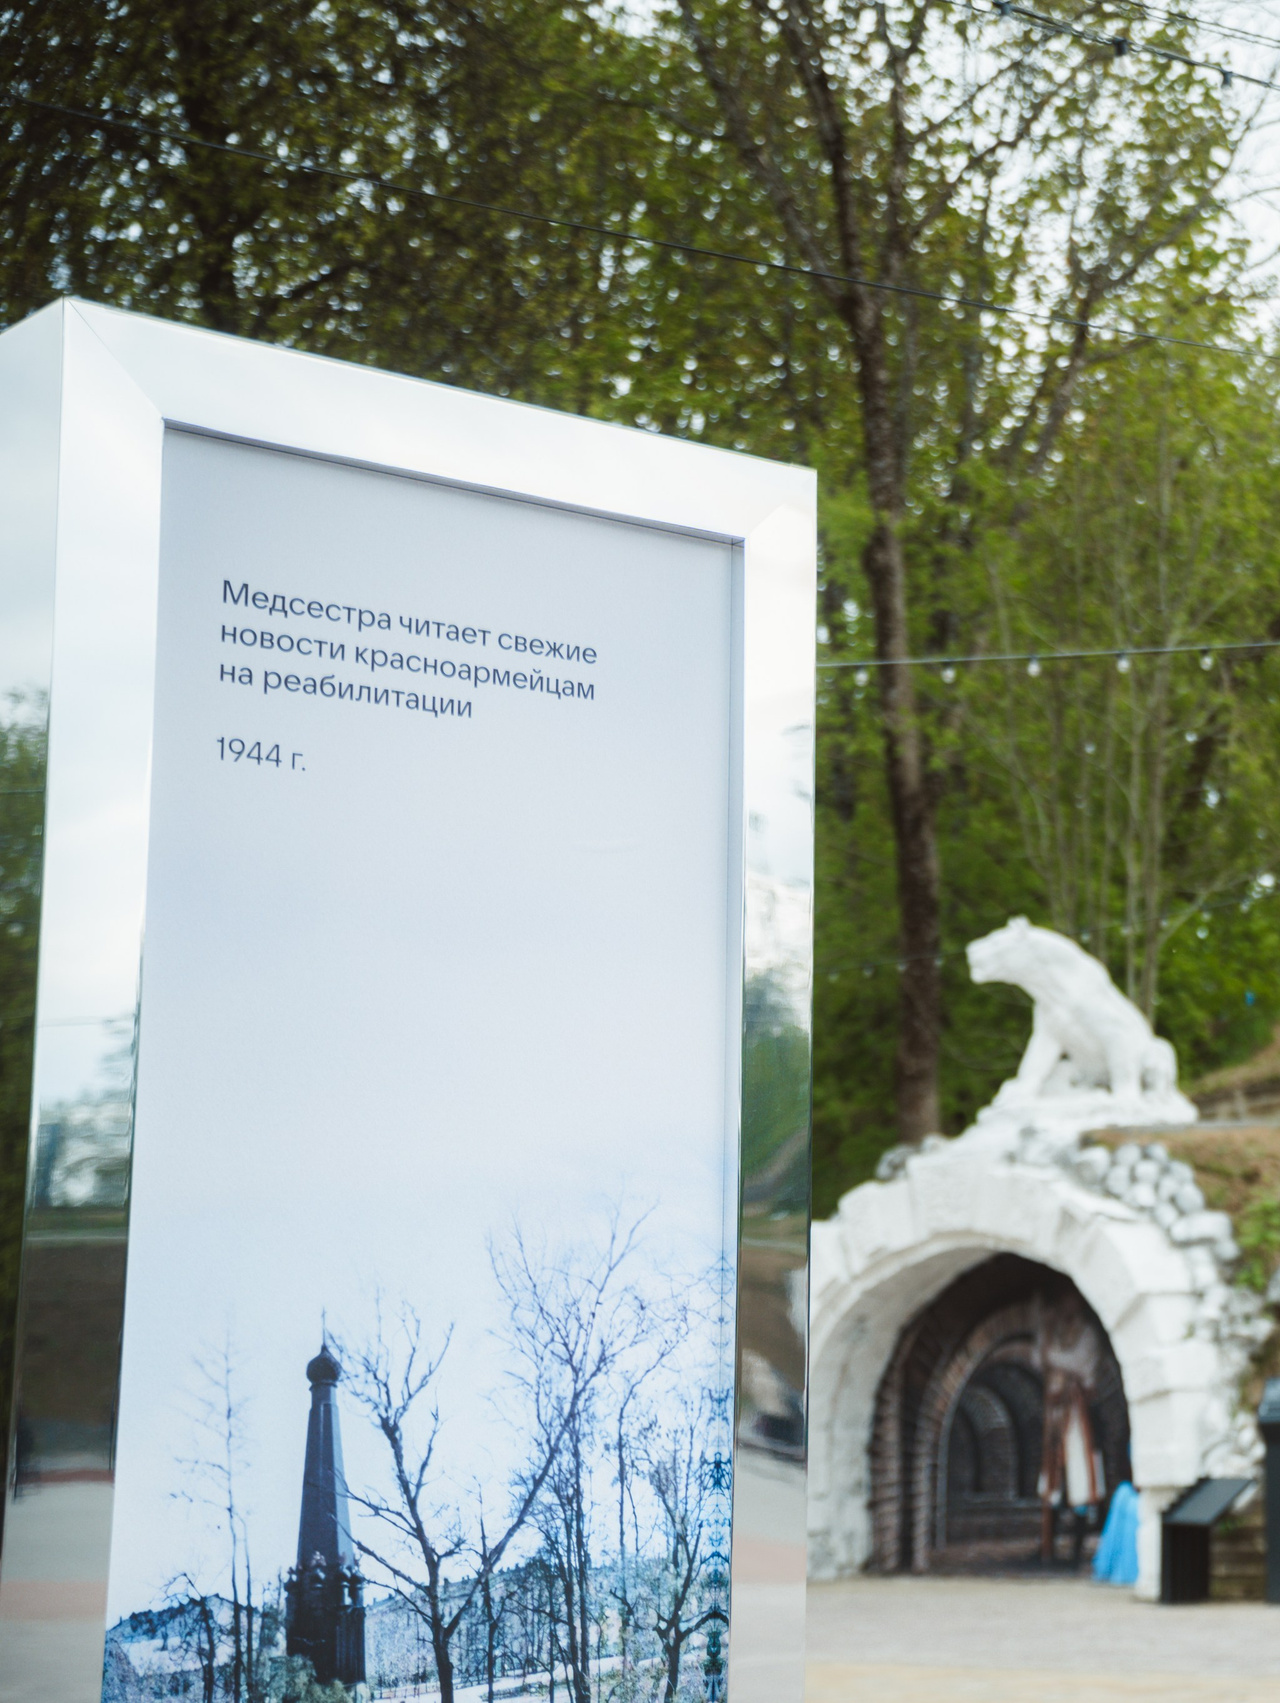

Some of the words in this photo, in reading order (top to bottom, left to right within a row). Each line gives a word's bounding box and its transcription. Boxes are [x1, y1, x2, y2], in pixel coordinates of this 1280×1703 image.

[222, 579, 392, 632] Медсестра
[398, 614, 492, 648] читает
[497, 630, 598, 665] свежие
[219, 663, 254, 686] на
[263, 668, 473, 718] реабилитации
[220, 624, 346, 661] новости
[354, 643, 596, 700] красноармейцам
[216, 736, 282, 768] 1944
[291, 751, 307, 771] г.
